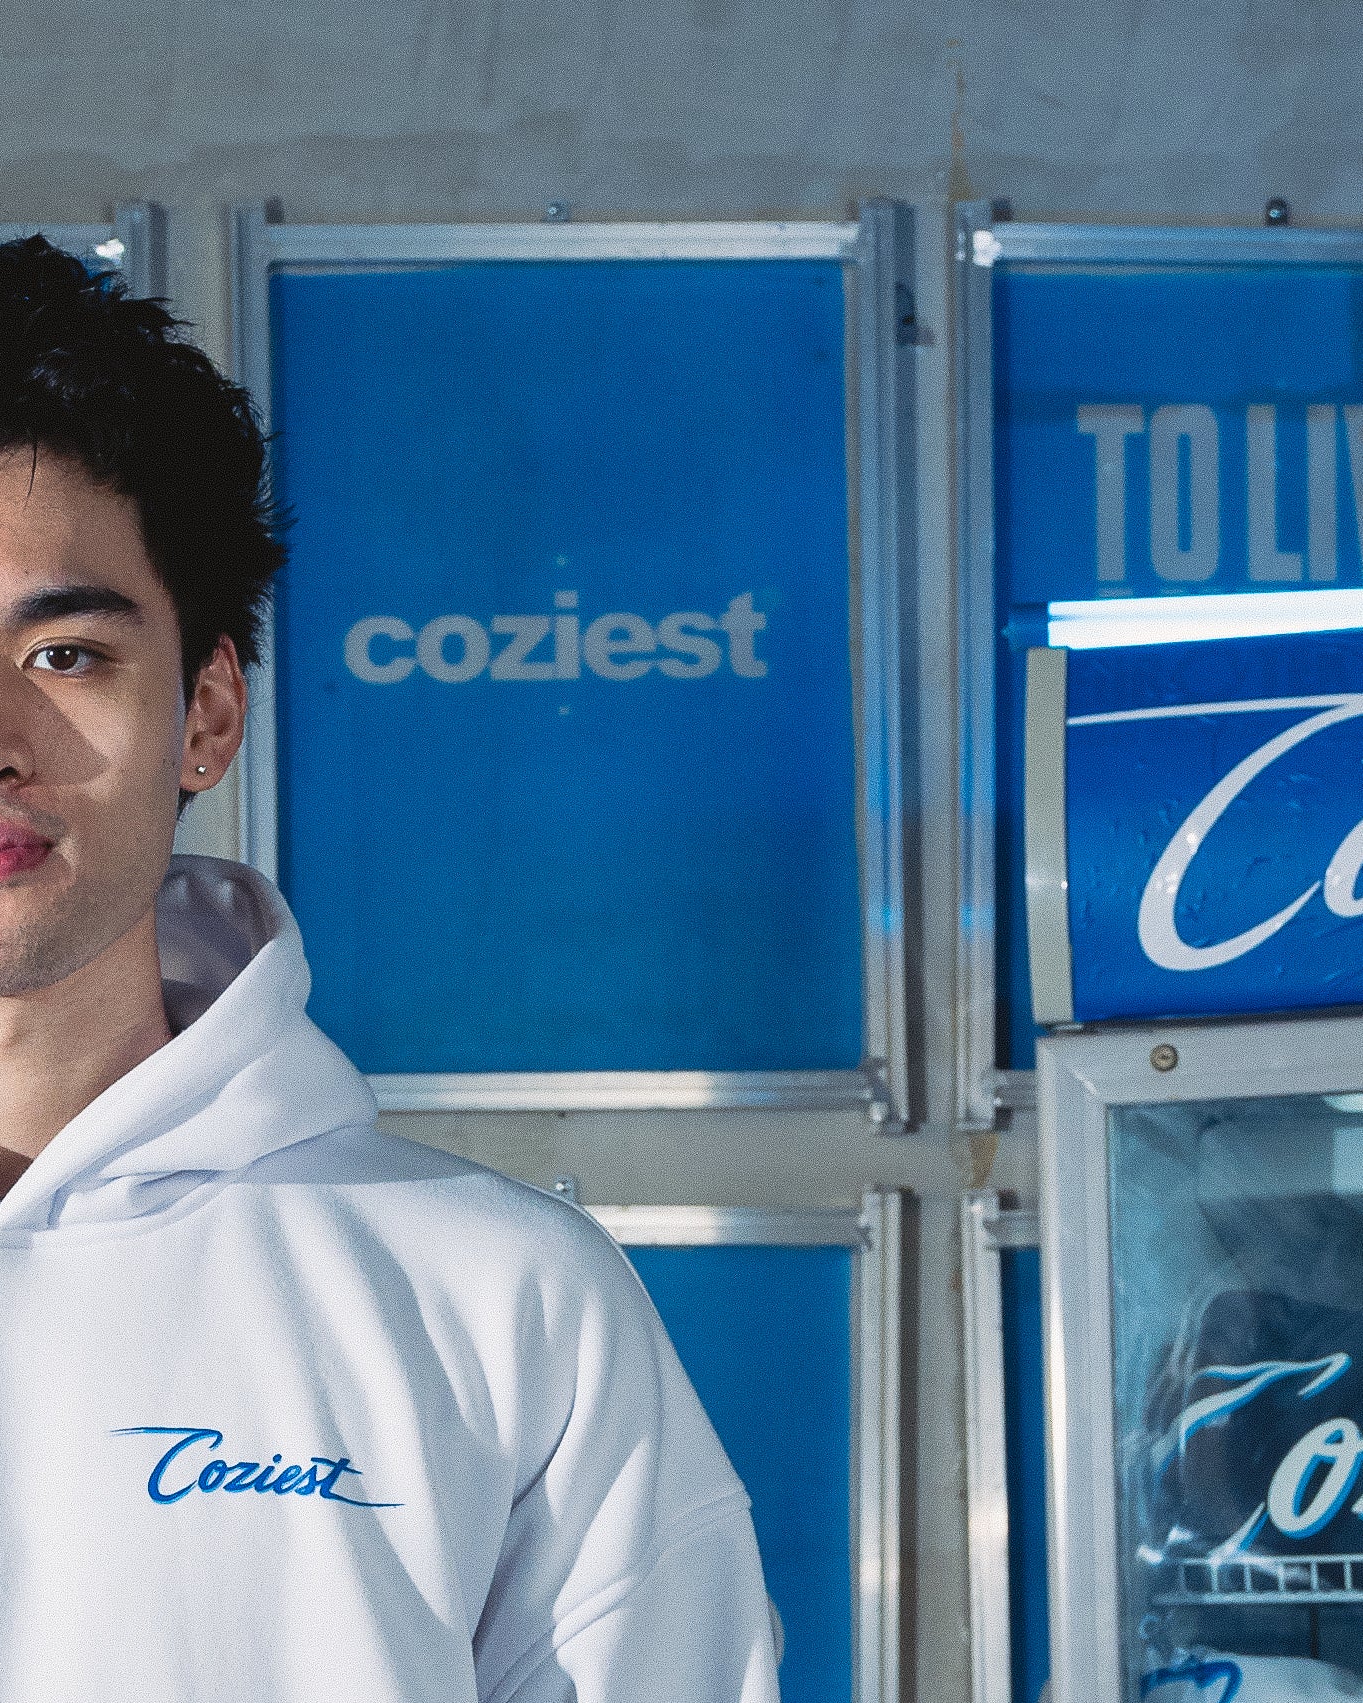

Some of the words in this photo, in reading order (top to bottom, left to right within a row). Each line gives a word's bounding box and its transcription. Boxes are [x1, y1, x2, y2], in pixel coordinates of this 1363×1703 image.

[1076, 403, 1221, 582] TO
[1246, 403, 1363, 582] LI
[343, 589, 768, 684] coziest
[107, 1426, 405, 1507] Coziest
